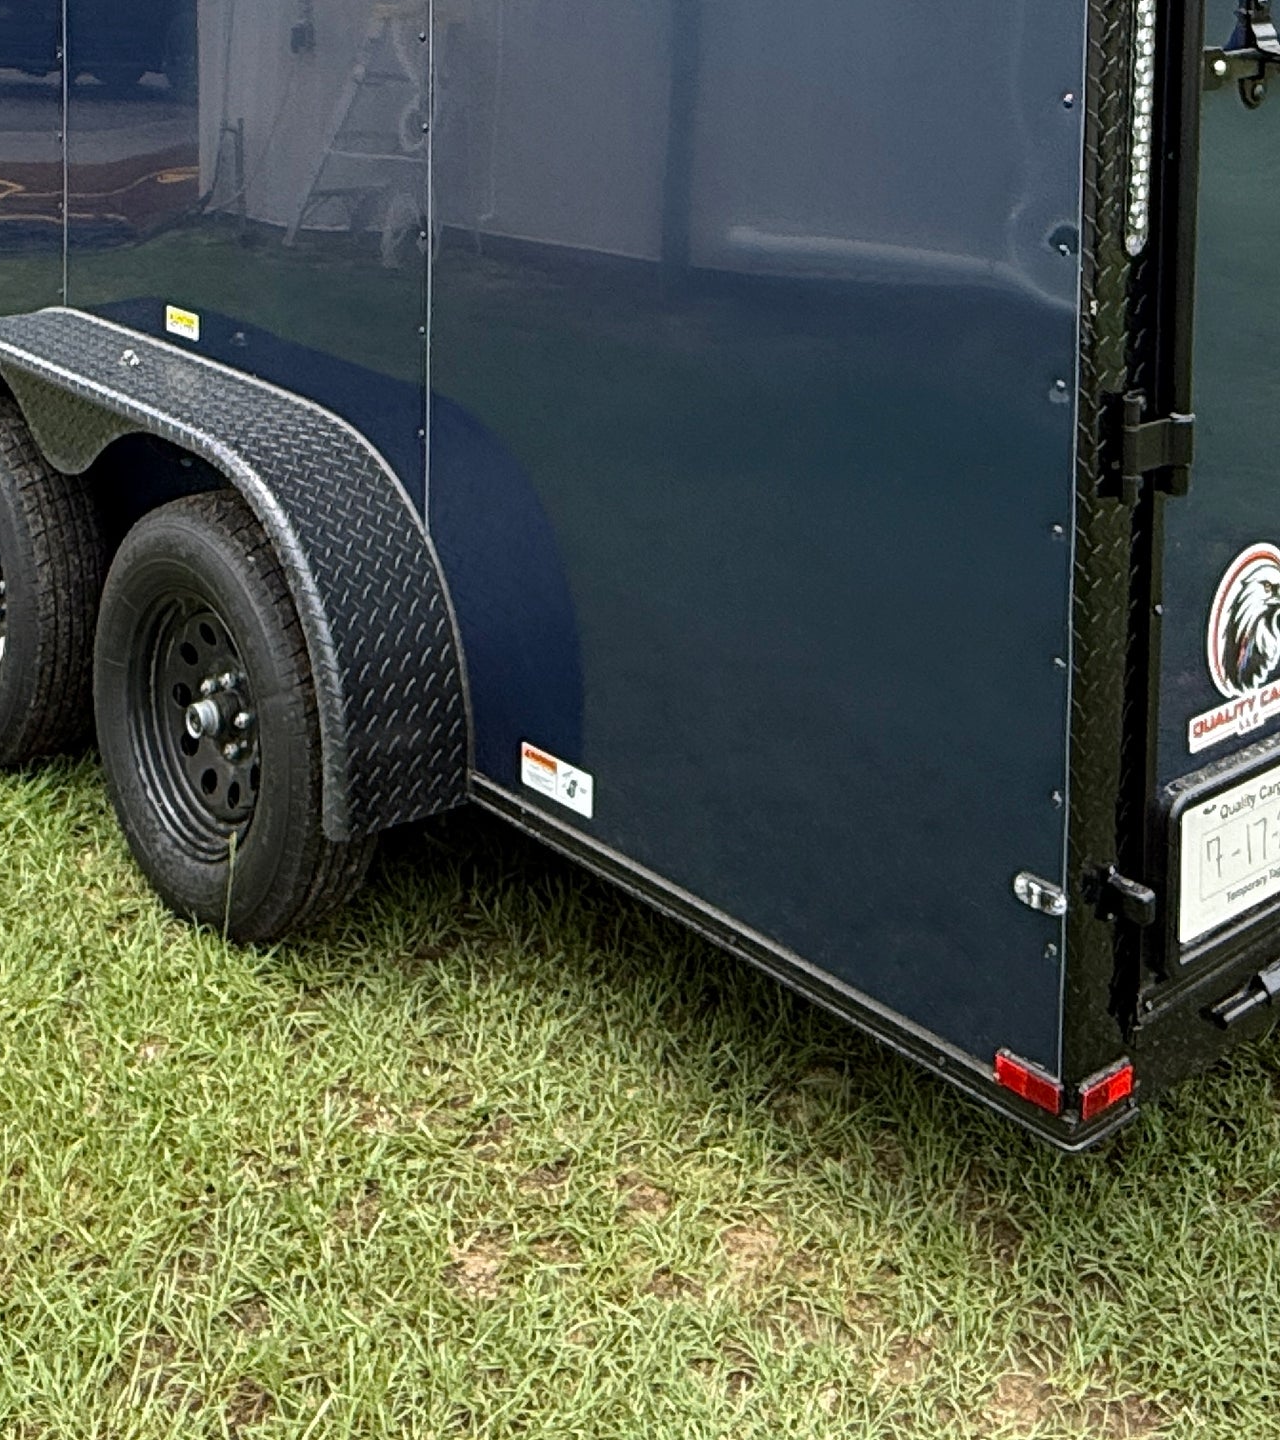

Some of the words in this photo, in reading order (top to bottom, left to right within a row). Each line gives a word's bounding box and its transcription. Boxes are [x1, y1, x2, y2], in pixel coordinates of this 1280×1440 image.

[1193, 695, 1257, 738] QUALITY
[1220, 794, 1257, 819] Quality
[1226, 875, 1268, 903] Temporary
